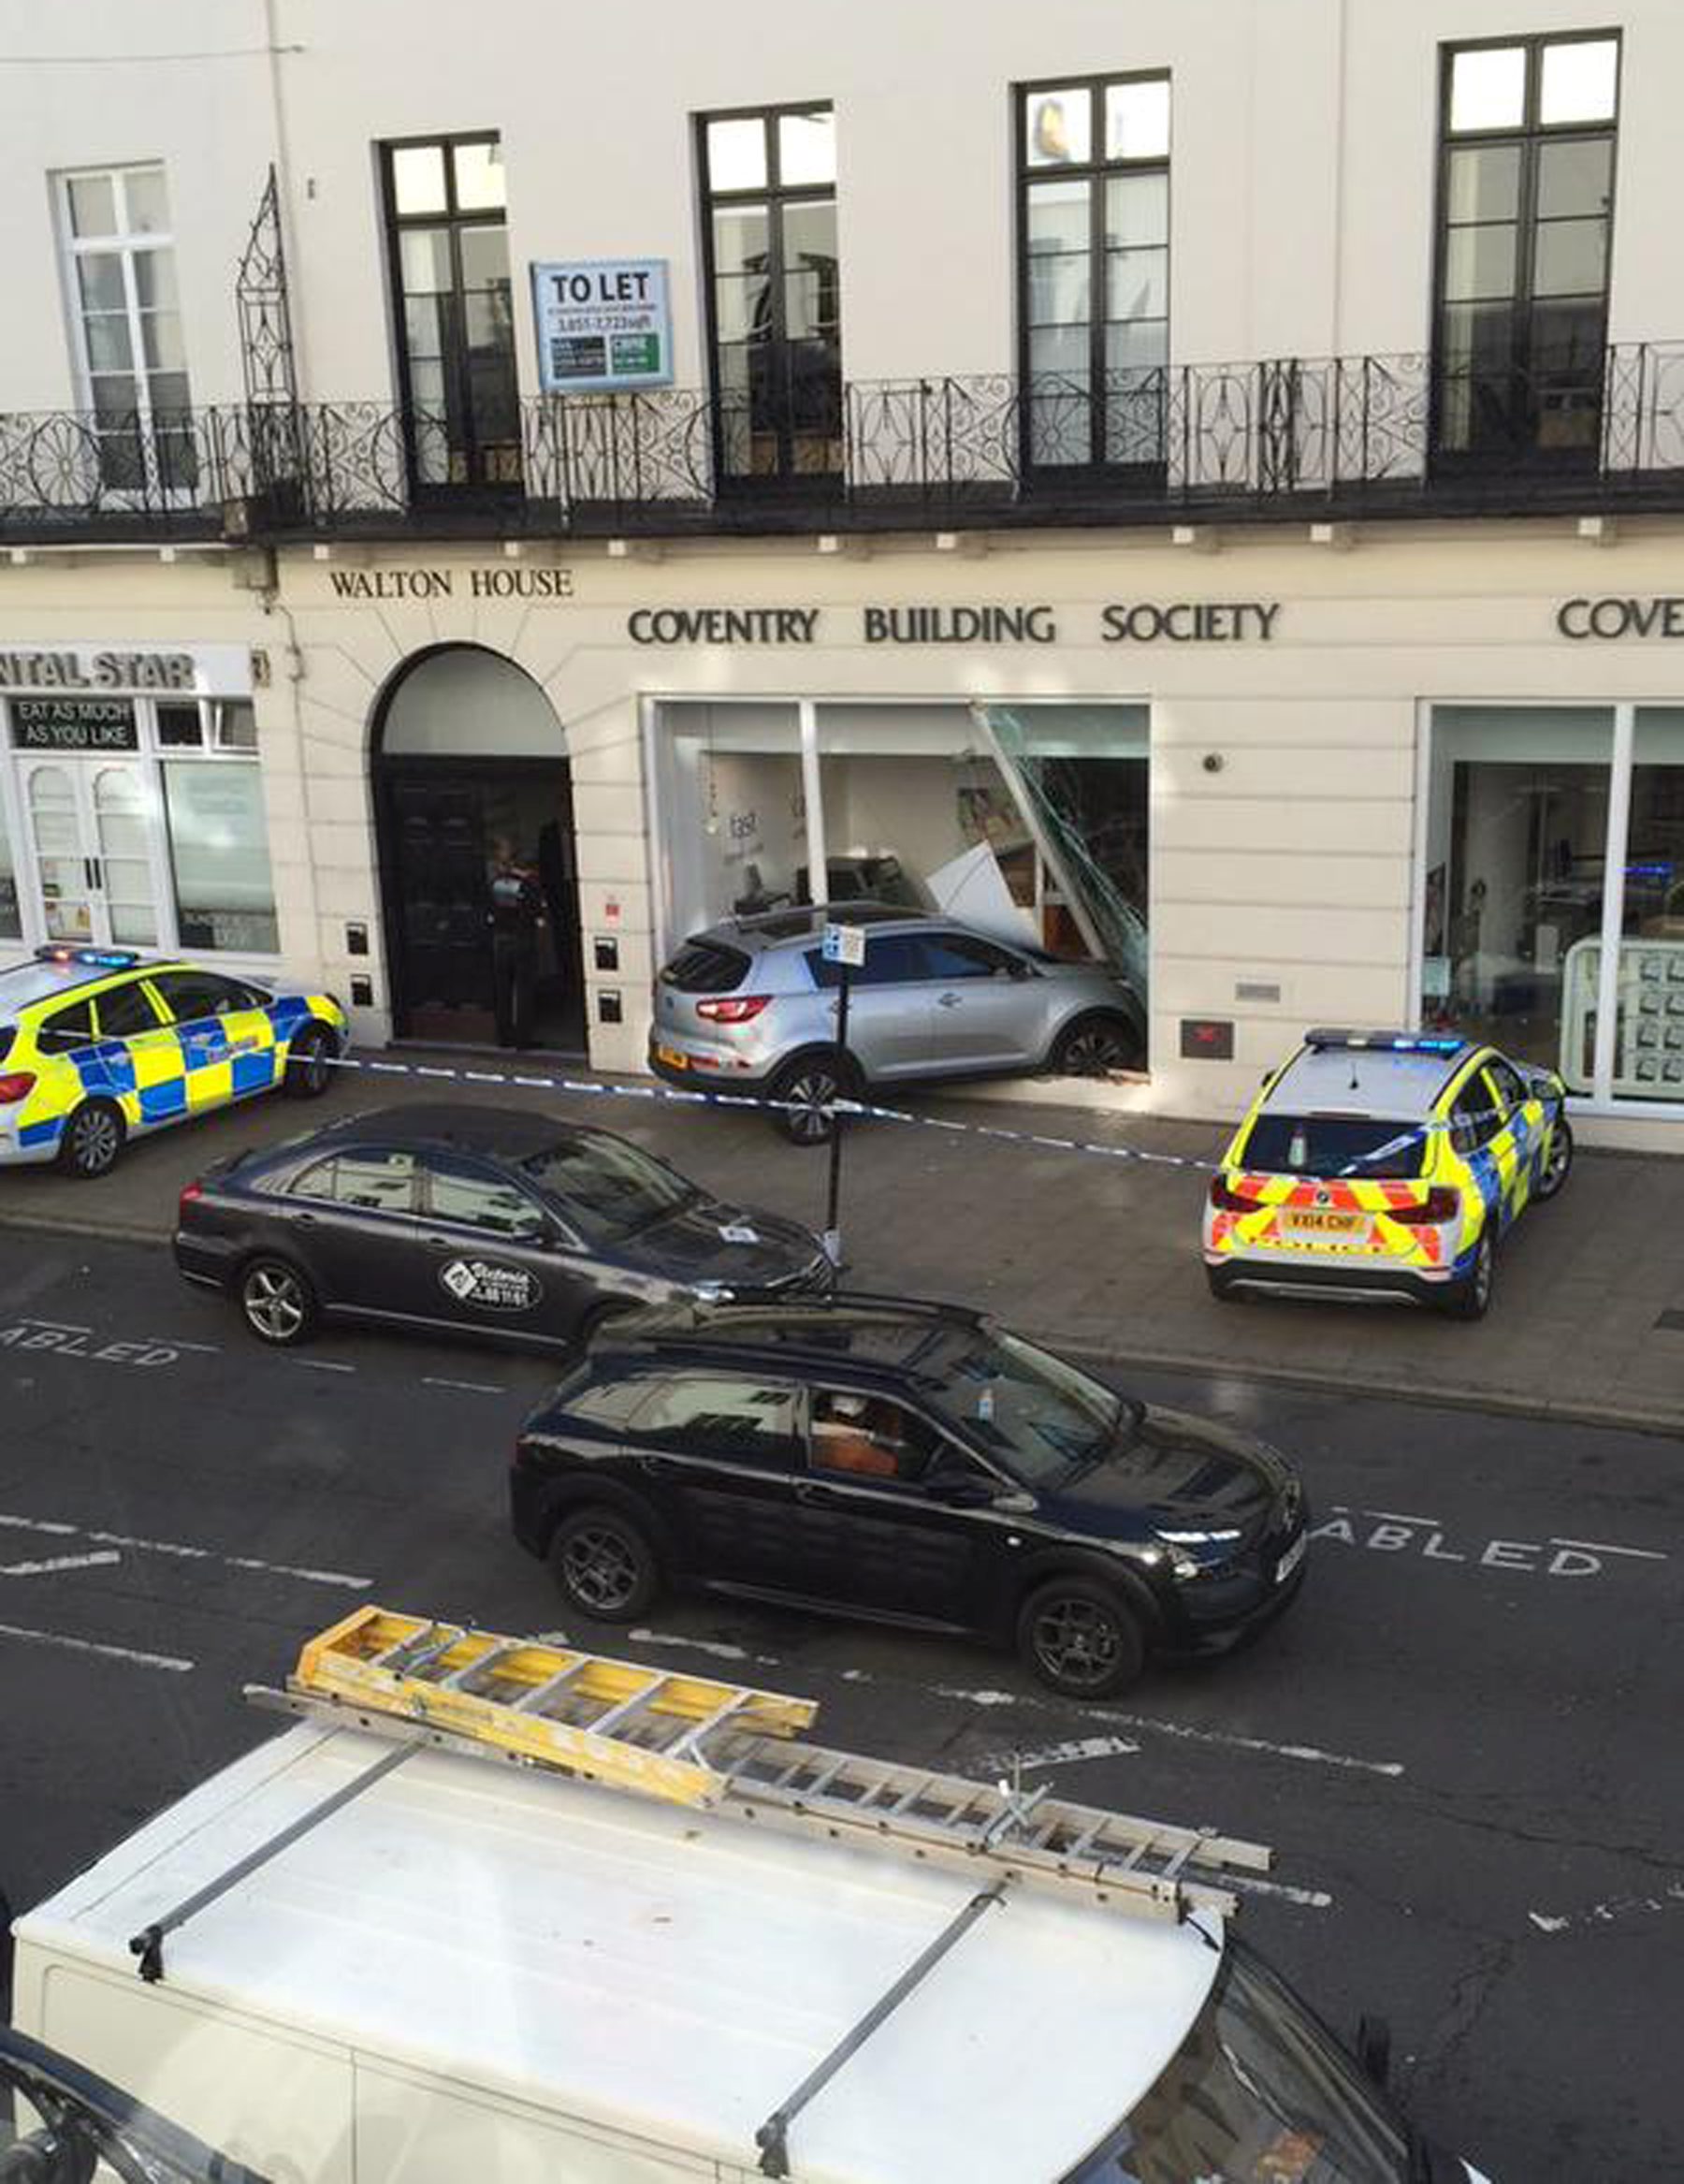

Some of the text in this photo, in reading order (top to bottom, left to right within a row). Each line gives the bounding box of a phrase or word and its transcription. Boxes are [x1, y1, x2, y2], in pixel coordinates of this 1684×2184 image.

[550, 271, 649, 303] TO LET
[330, 569, 574, 599] WALTON HOUSE
[628, 603, 1280, 644] COVENTRY BUILDING SOCIETY
[94, 651, 196, 690] STAR
[20, 703, 131, 721] EAT AS MUCH
[26, 726, 127, 745] AS YOU LIKE
[1309, 1519, 1602, 1576] ABLED
